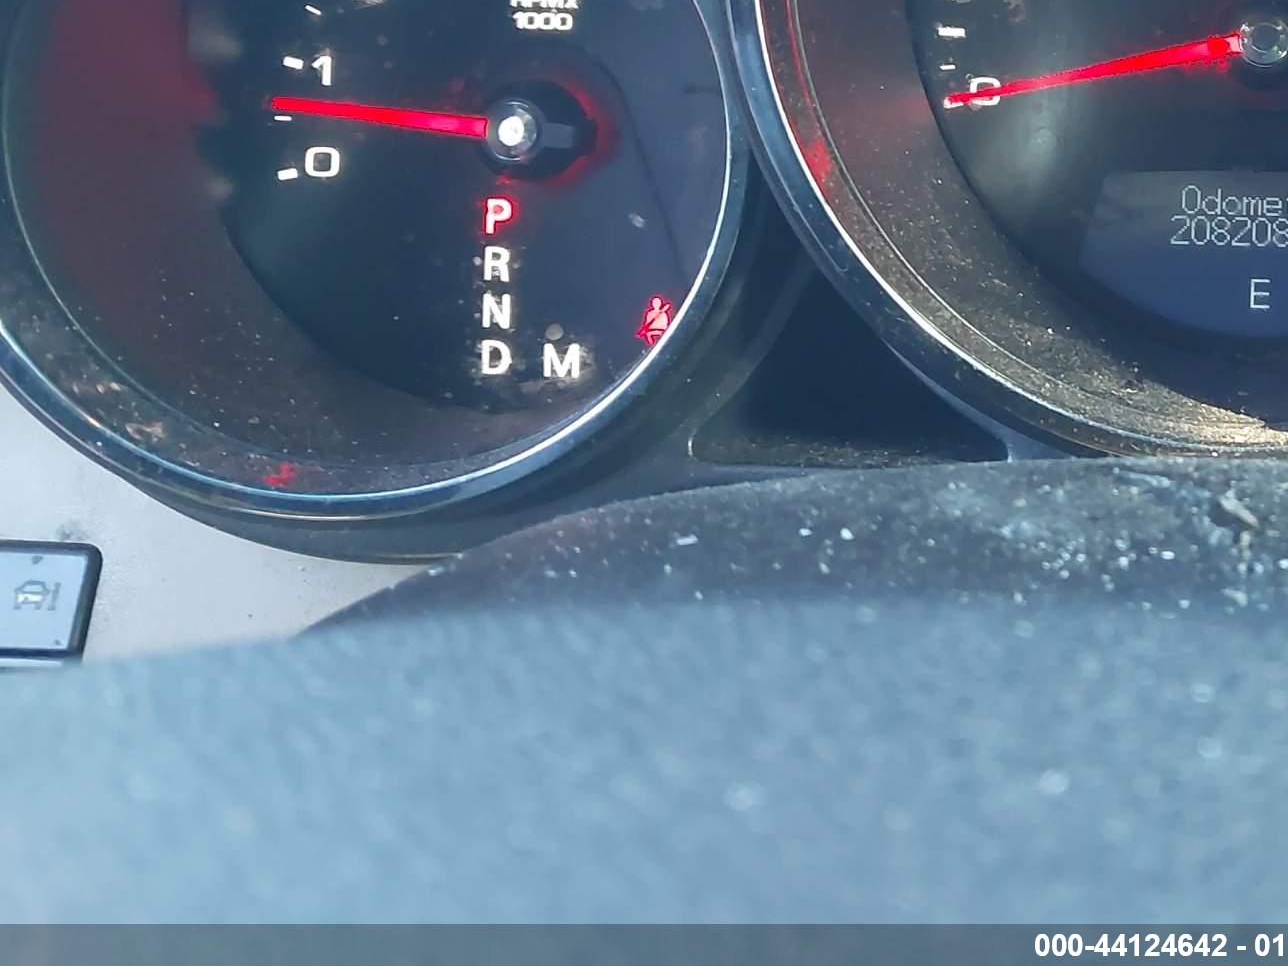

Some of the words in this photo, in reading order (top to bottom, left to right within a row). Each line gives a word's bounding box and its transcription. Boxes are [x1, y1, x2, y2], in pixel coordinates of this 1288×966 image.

[512, 11, 573, 31] 1000
[312, 55, 333, 86] 1
[969, 76, 1001, 106] 0
[304, 147, 340, 178] 0
[484, 198, 513, 234] P
[482, 246, 510, 282] R
[1249, 278, 1271, 309] E
[481, 293, 511, 329] N
[481, 341, 511, 375] D
[543, 344, 580, 378] M
